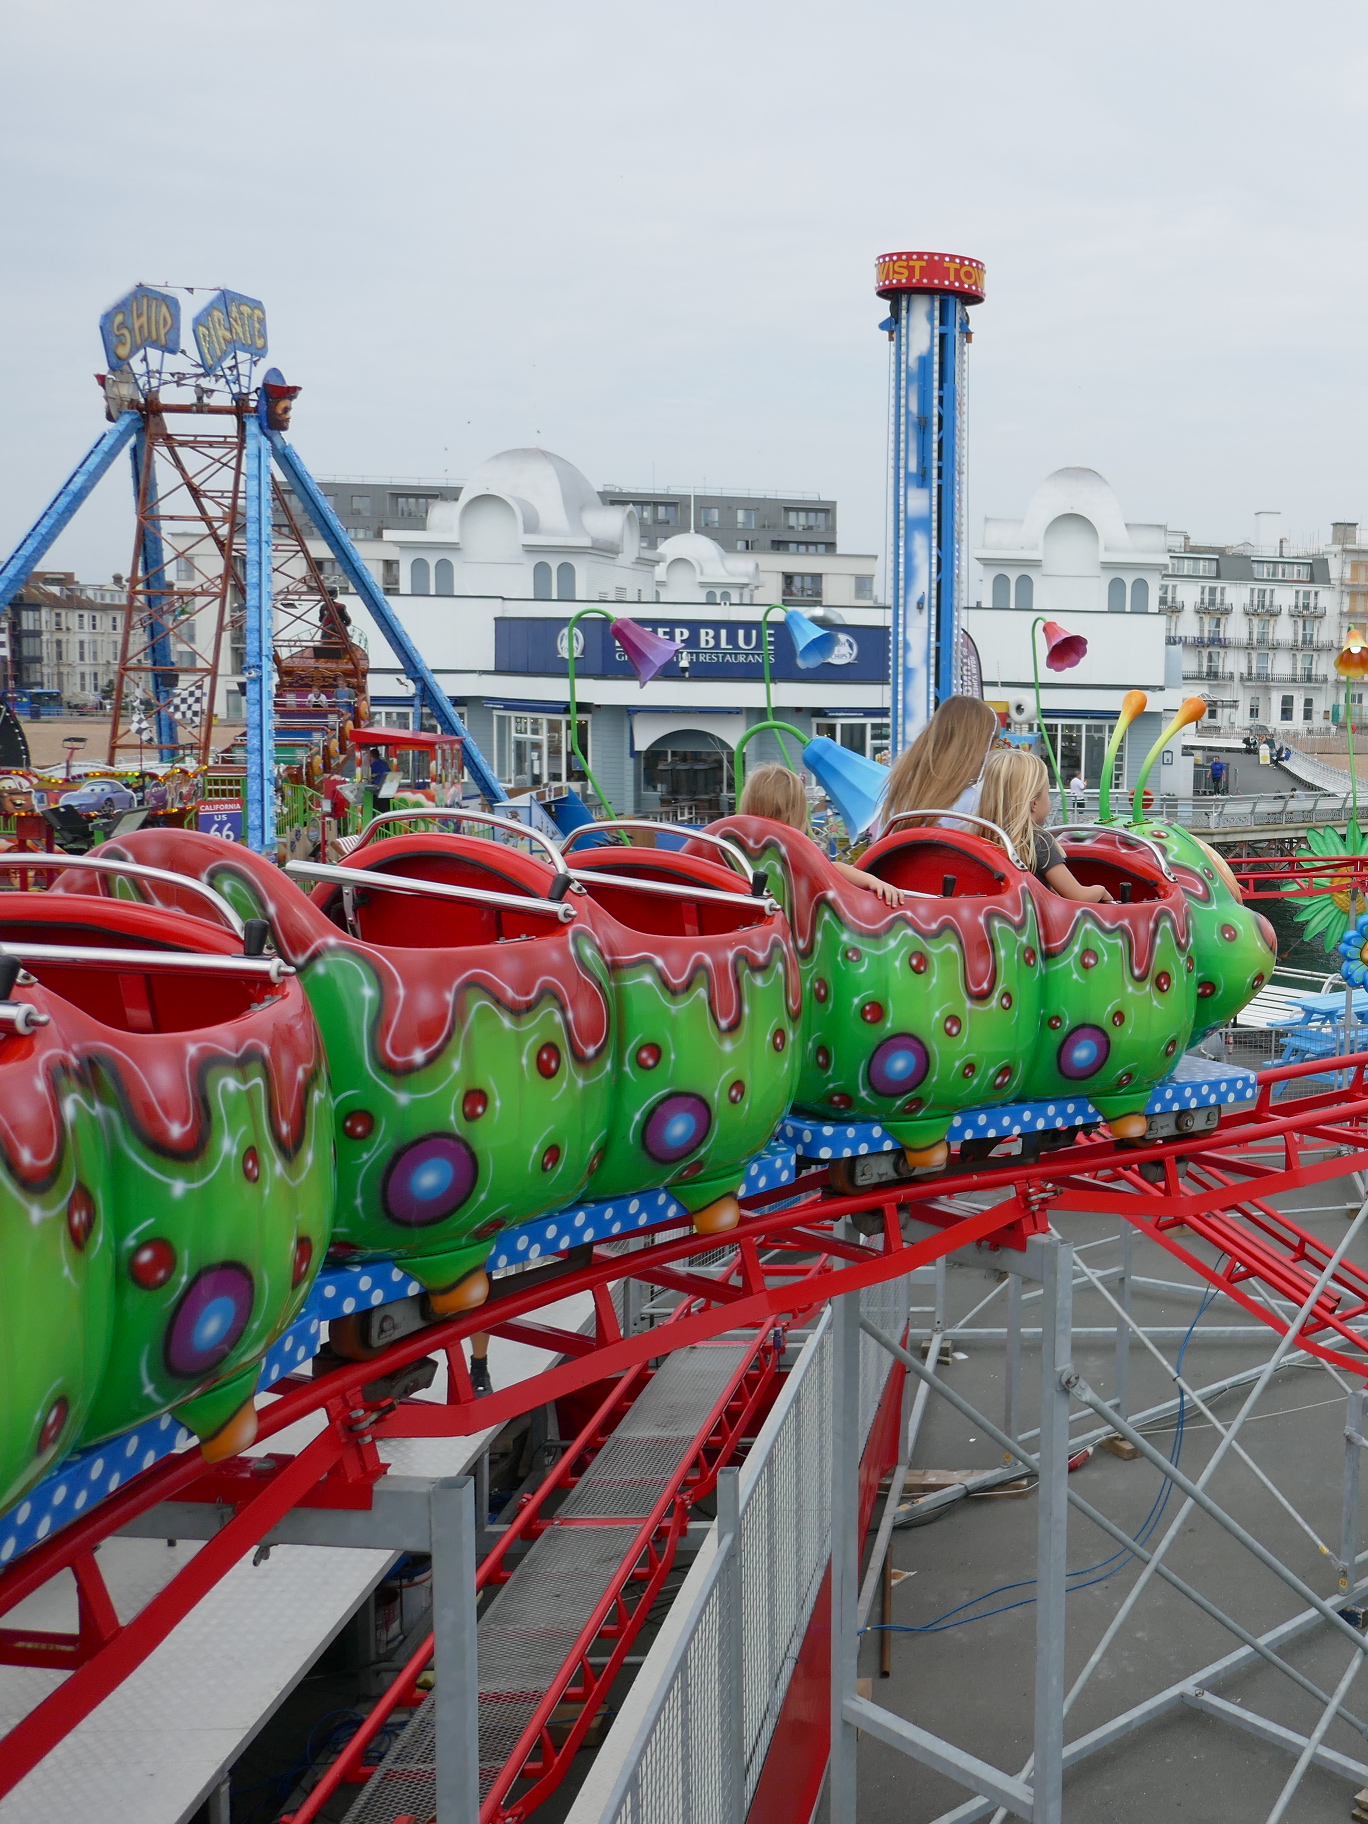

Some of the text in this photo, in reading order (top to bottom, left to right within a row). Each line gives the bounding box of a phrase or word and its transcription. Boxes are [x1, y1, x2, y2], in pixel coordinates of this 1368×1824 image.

[112, 294, 173, 361] SHIP
[197, 300, 266, 370] PIRATE
[699, 628, 775, 650] BLUE
[200, 803, 241, 811] CALIFORNIA
[210, 823, 234, 841] 66
